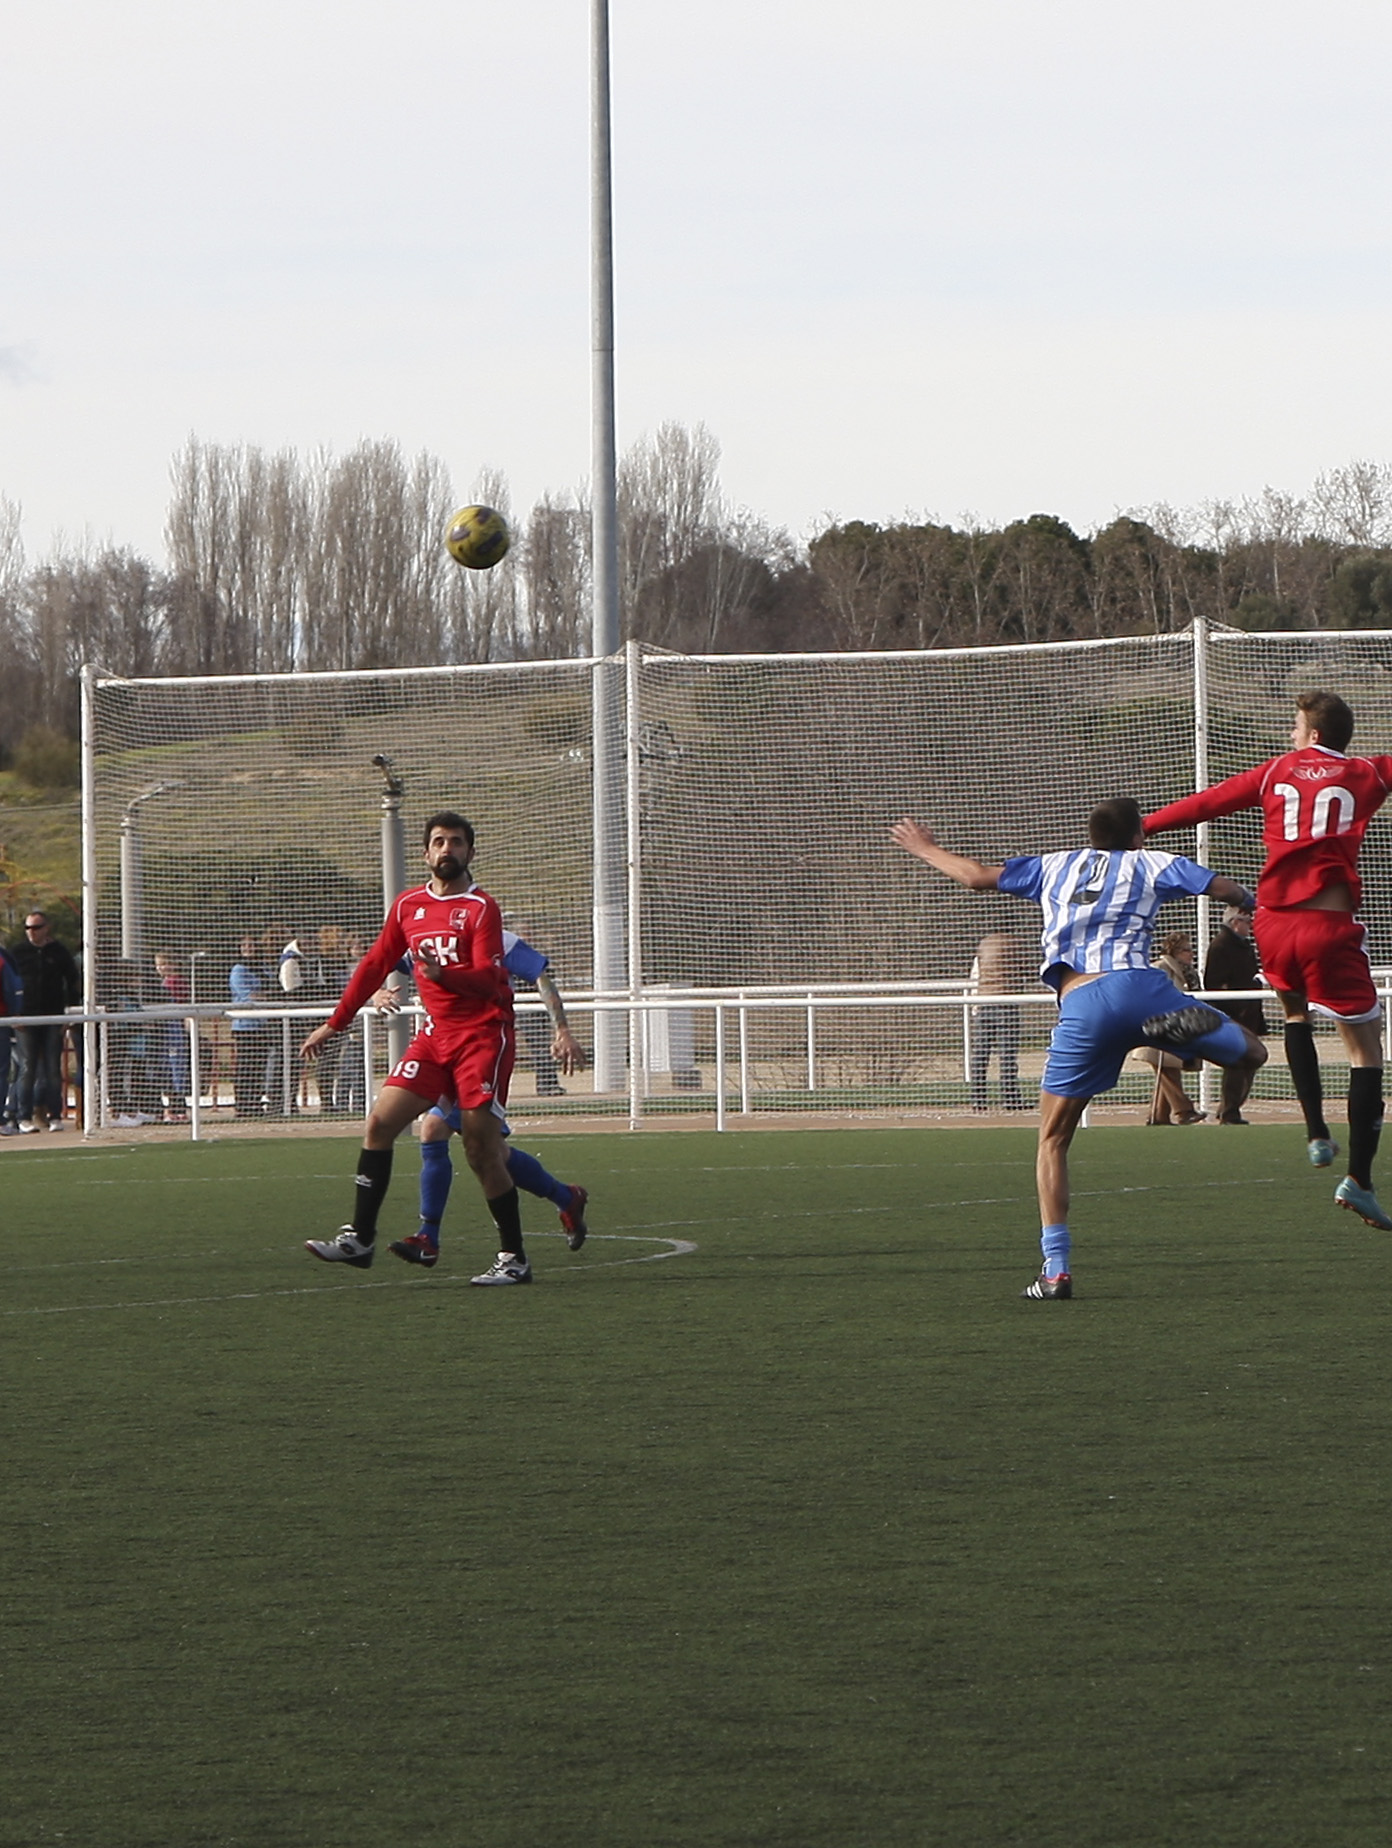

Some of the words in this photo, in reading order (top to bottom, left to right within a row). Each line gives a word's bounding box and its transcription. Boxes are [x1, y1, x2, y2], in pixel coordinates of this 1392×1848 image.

[1274, 783, 1355, 840] 10
[1068, 853, 1109, 905] 2
[393, 1061, 419, 1079] 19
